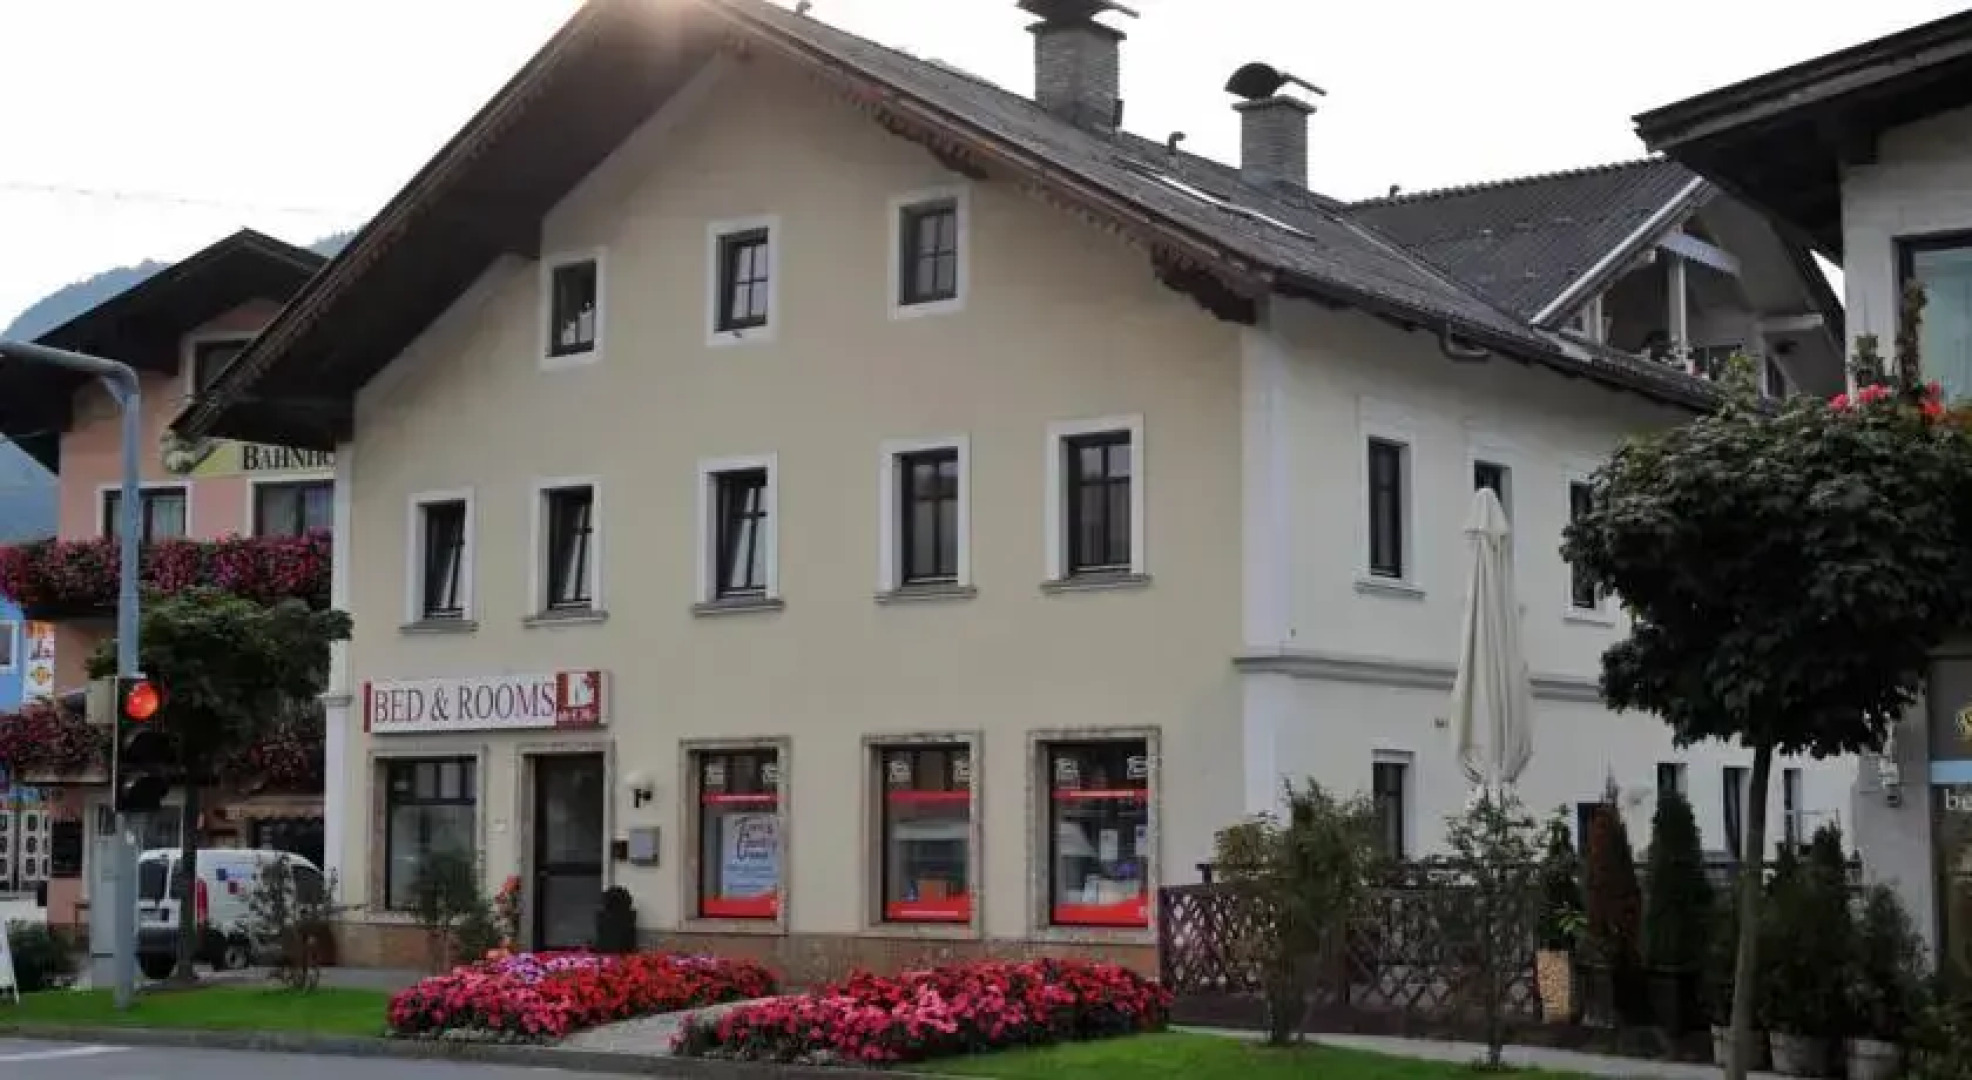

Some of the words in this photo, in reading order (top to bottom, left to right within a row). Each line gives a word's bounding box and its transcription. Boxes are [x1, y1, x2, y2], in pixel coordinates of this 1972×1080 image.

[375, 689, 424, 723] BED
[430, 687, 449, 722] &
[457, 681, 556, 720] ROOMS
